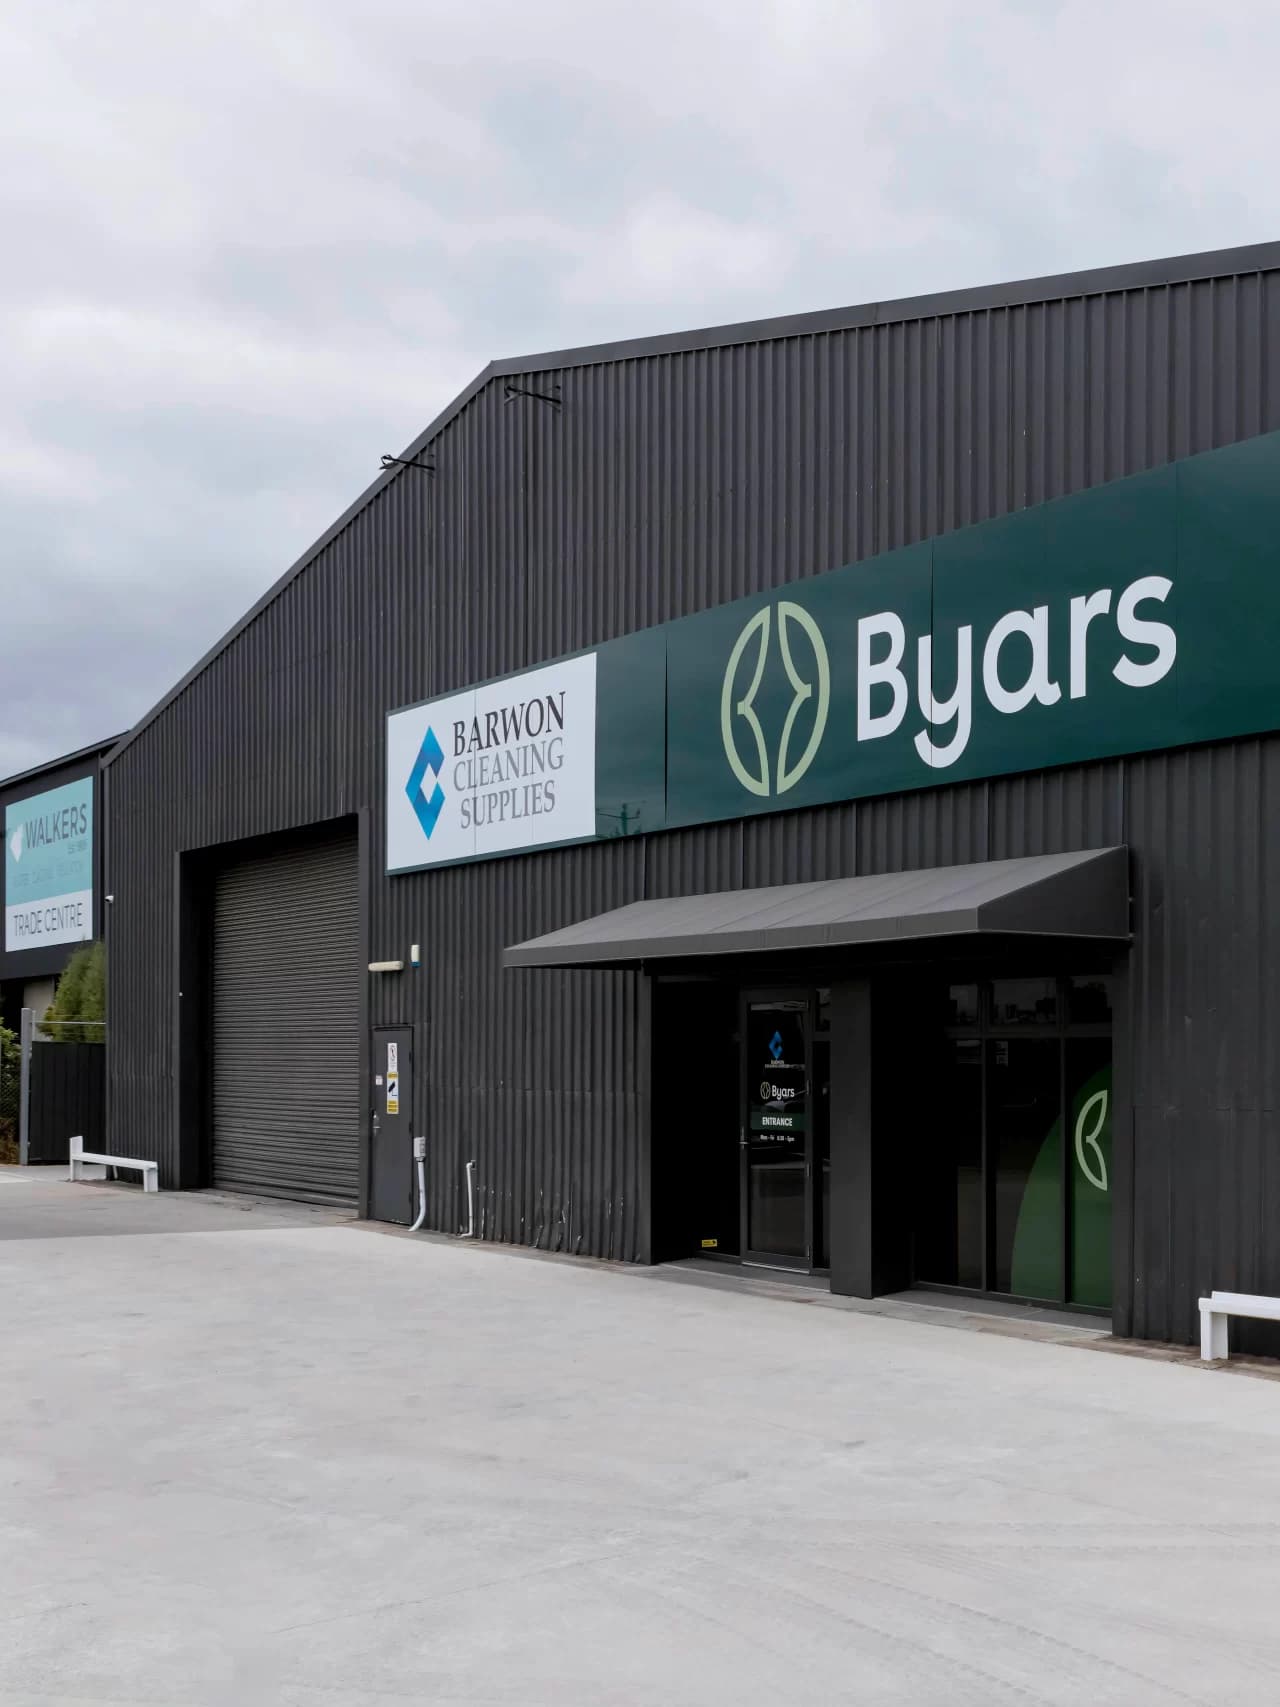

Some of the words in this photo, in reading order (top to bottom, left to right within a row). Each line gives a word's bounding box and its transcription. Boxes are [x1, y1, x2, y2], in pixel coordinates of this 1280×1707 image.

[857, 575, 1177, 768] Byars
[452, 691, 566, 757] BARWON
[453, 737, 565, 792] CLEANING
[24, 803, 88, 849] WALKERS
[460, 780, 556, 829] SUPPLIES
[13, 910, 43, 937] TRADE
[44, 903, 83, 932] CENTRE
[771, 1085, 795, 1100] Byars
[762, 1117, 792, 1126] ENTRANCE
